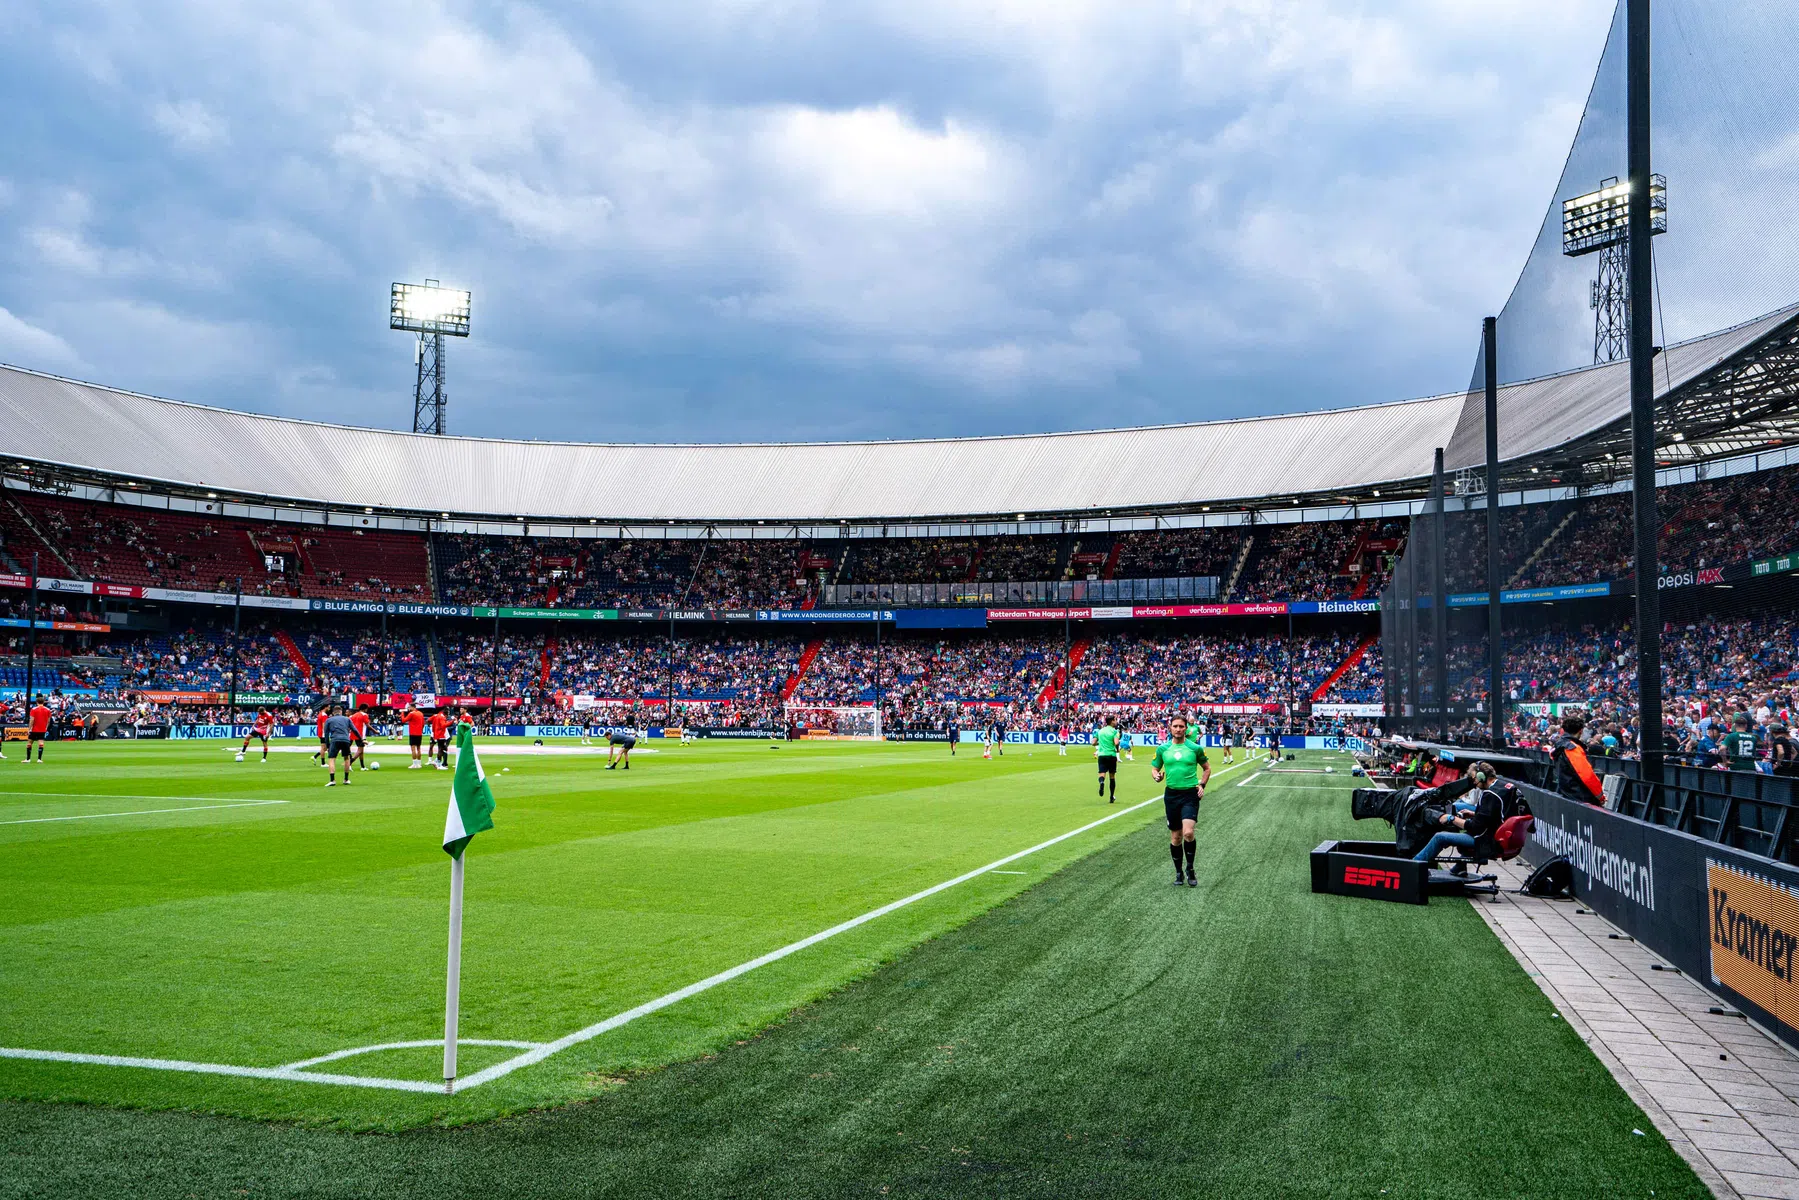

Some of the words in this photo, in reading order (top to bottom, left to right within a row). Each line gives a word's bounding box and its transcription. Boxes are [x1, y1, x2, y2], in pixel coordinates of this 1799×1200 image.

[1755, 562, 1770, 574] TOTO
[1776, 558, 1791, 571] TOTO
[1657, 571, 1694, 590] pepsi
[1696, 566, 1725, 585] MAX
[324, 602, 350, 611] BLUE
[351, 603, 384, 612] AMIGO
[398, 605, 424, 613] BLUE
[425, 606, 457, 615] AMIGO
[1318, 601, 1376, 613] Heineken
[1043, 610, 1065, 619] Hague
[183, 726, 228, 738] KUKEN
[538, 727, 583, 737] KEUKEN
[975, 732, 1029, 743] KUKEN
[1323, 737, 1362, 749] KEKEN
[1738, 740, 1754, 756] 12
[1344, 866, 1401, 890] ESPN
[1712, 888, 1799, 984] Kramer
